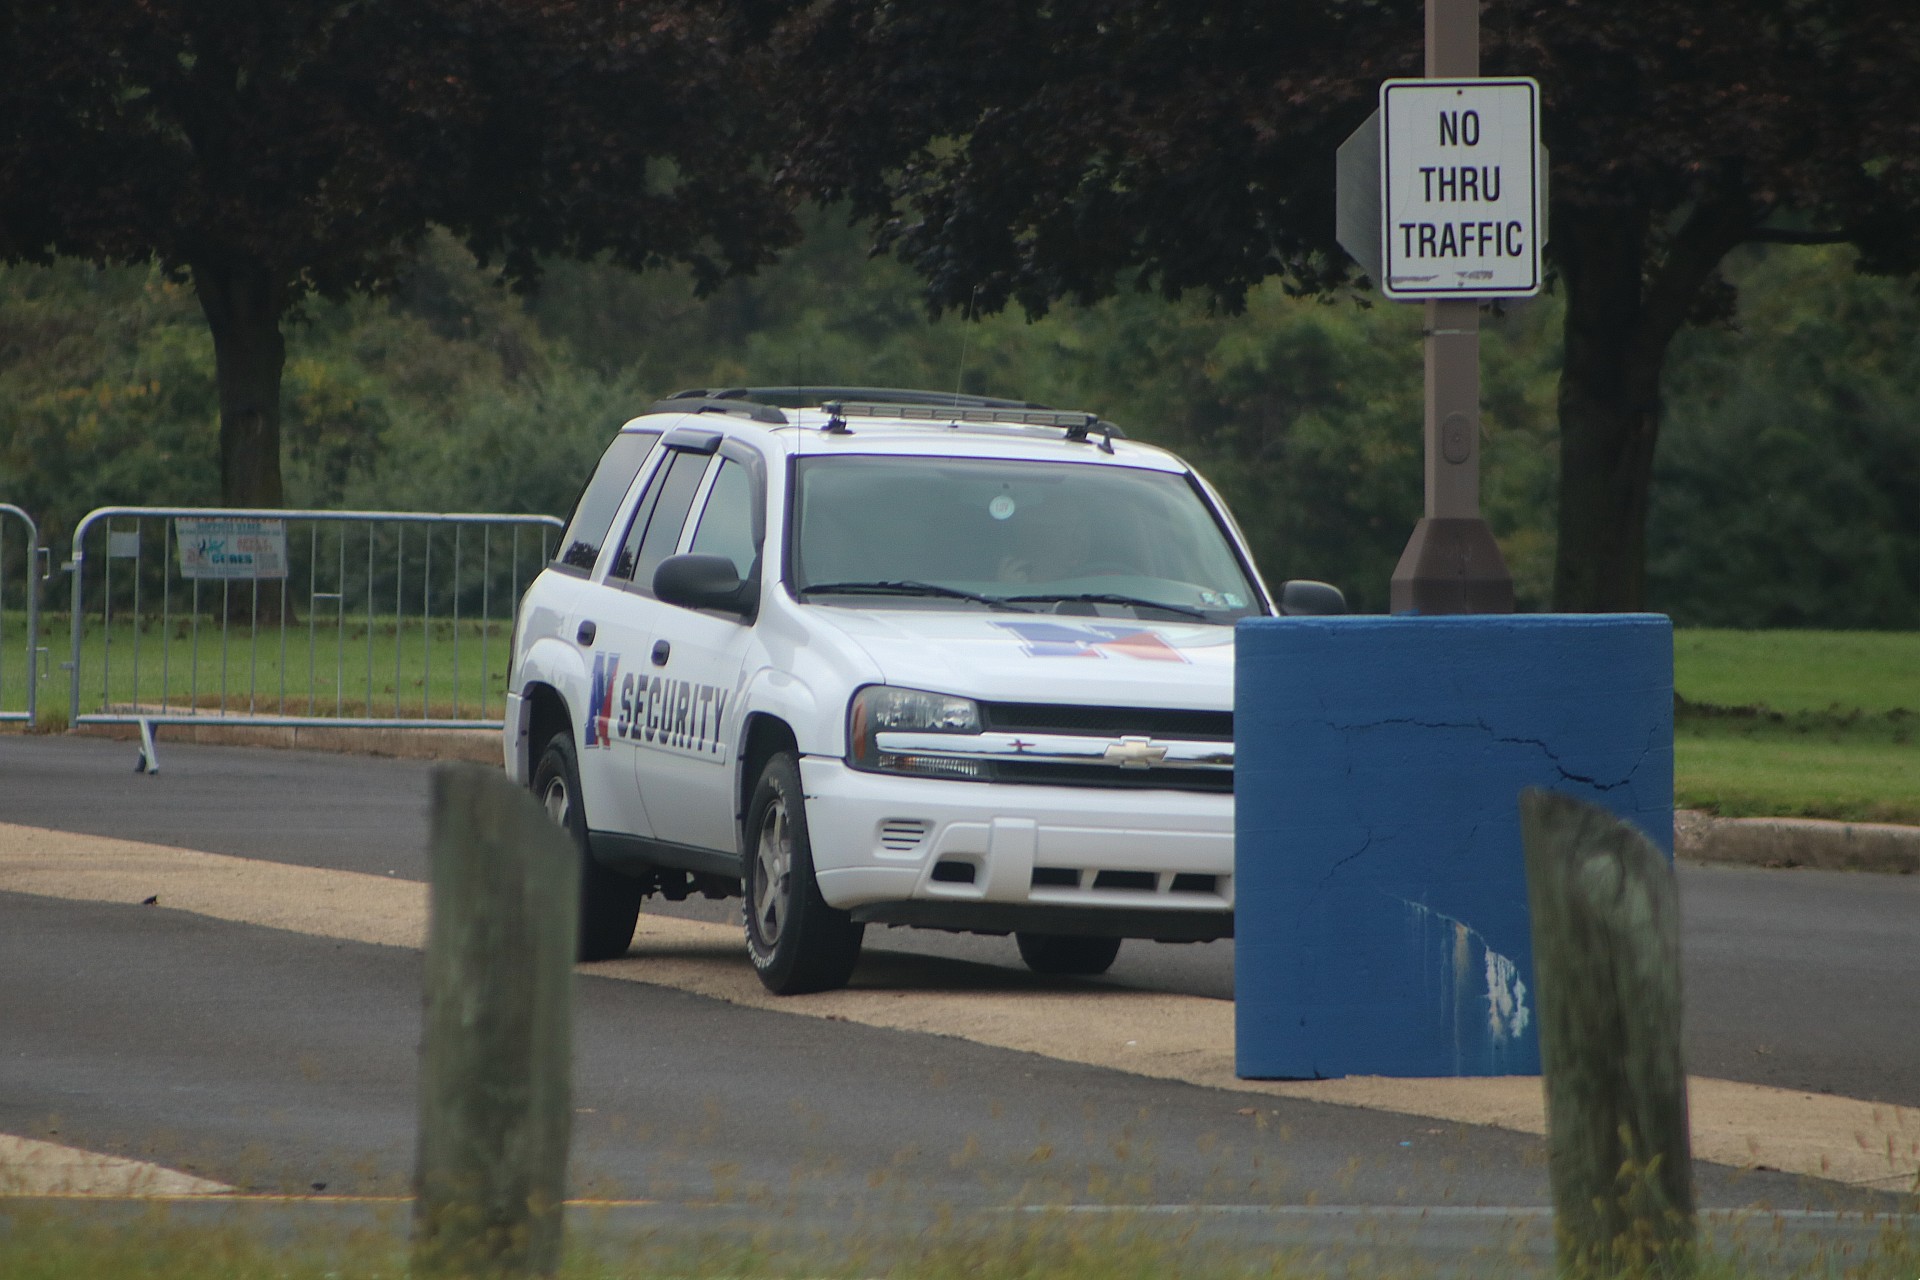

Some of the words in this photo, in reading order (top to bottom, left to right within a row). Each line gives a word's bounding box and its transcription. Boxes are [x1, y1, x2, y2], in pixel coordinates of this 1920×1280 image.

[1439, 110, 1480, 146] NO
[1419, 166, 1500, 202] THRU
[1399, 221, 1523, 258] TRAFFIC
[617, 672, 729, 754] SECURITY
